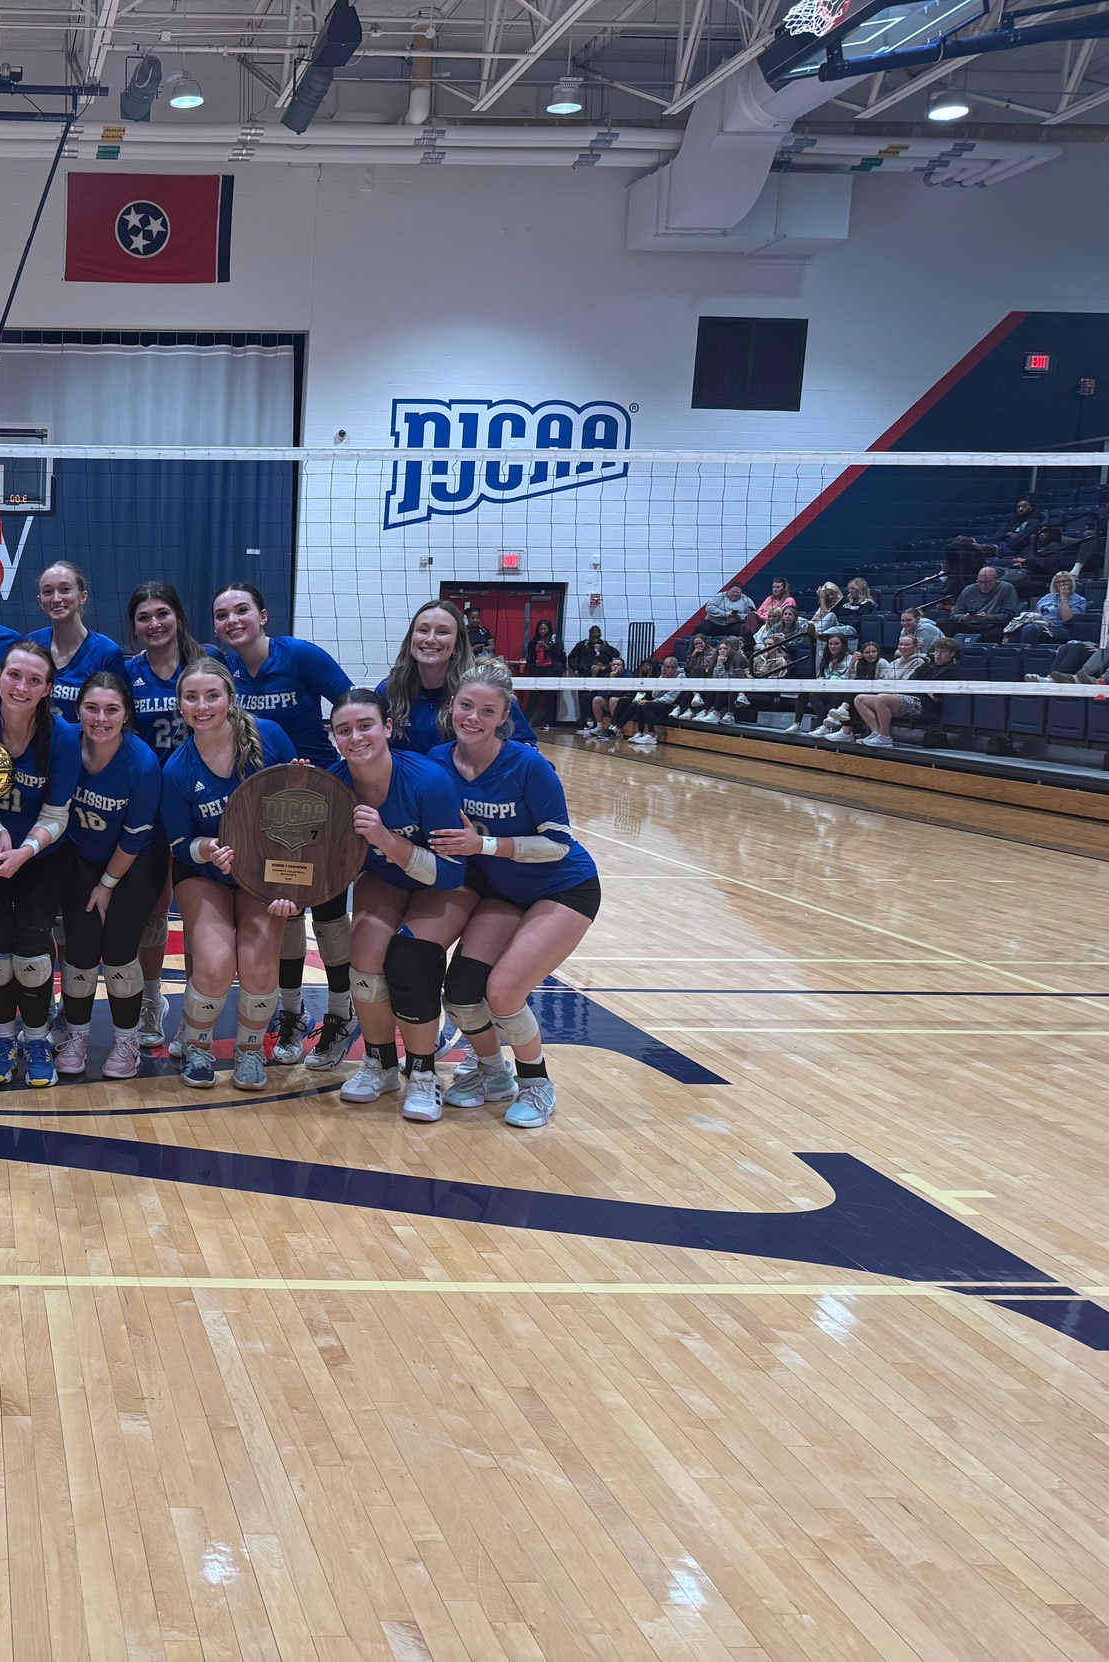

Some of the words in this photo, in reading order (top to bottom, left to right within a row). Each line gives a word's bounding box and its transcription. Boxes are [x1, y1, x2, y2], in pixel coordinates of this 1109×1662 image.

[134, 696, 178, 714] PELLIS
[263, 799, 328, 828] NJCAA
[310, 830, 320, 841] 7
